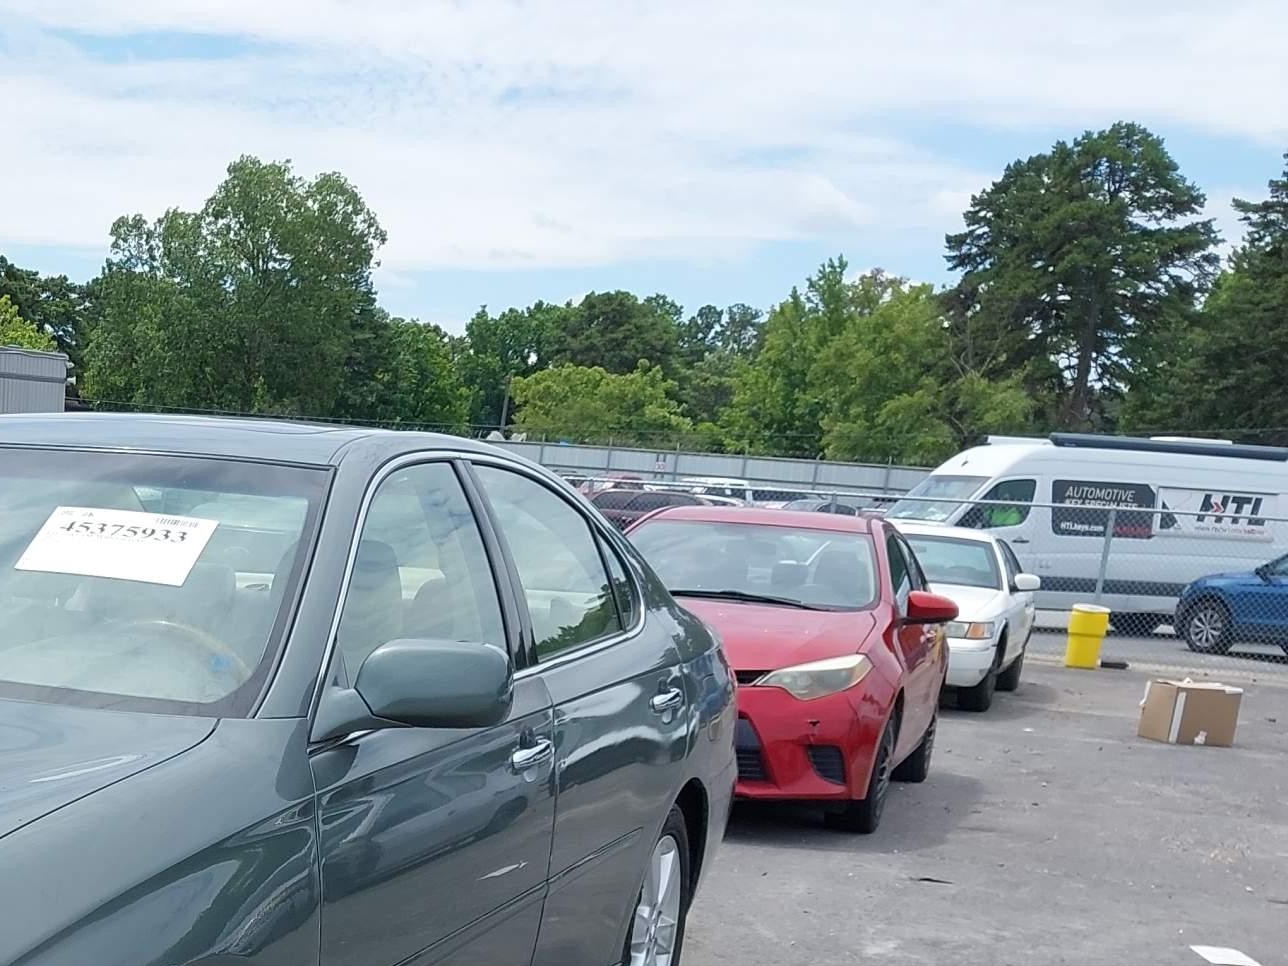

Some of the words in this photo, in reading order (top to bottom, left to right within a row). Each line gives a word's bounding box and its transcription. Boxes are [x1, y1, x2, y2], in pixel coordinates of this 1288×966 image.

[1065, 486, 1135, 501] AUTOMOTIVE
[1197, 494, 1265, 526] HTL
[59, 520, 188, 544] 45375933
